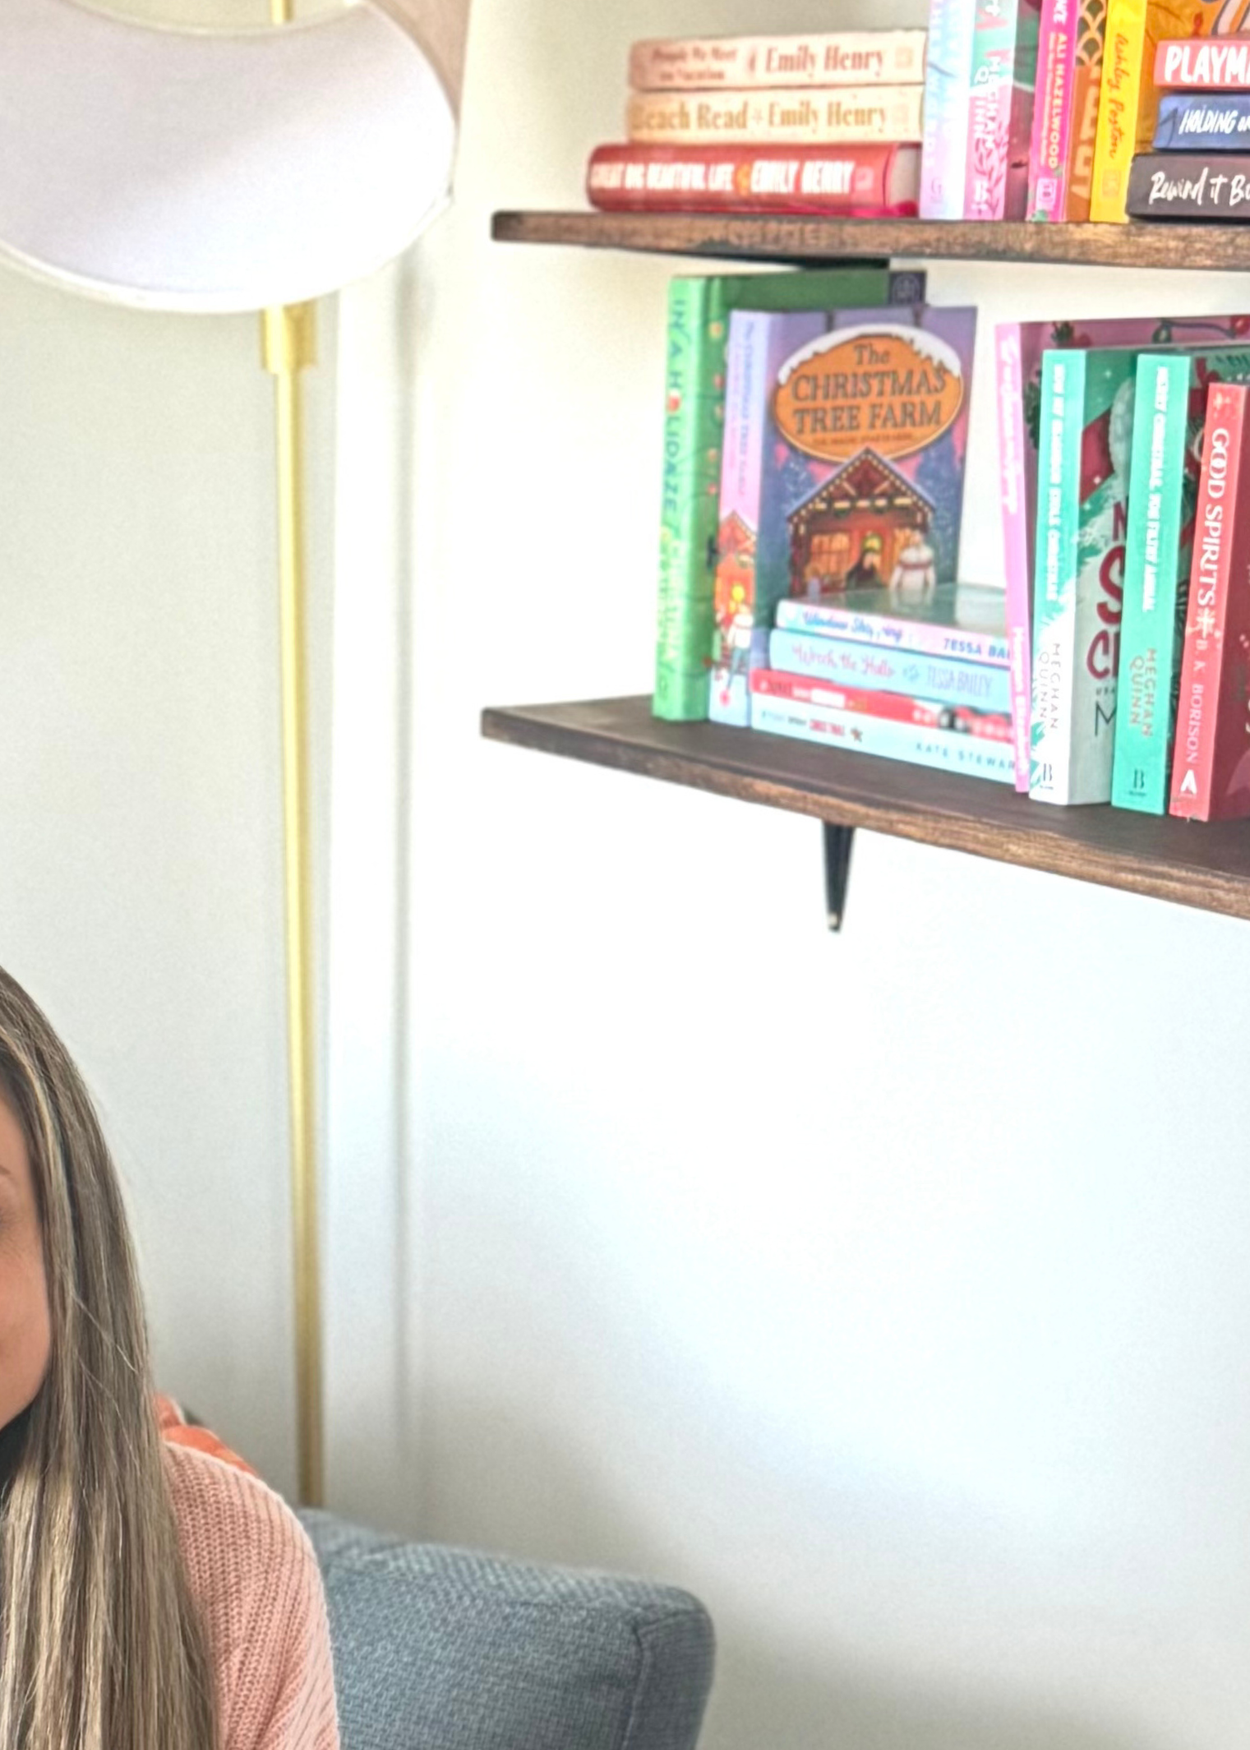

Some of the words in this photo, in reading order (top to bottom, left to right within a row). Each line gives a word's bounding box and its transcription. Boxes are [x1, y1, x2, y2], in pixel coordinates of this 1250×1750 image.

[765, 44, 816, 78] Emily
[823, 44, 884, 77] Henry
[1056, 32, 1068, 58] ALI
[1107, 32, 1130, 91] Ashley
[1164, 45, 1250, 85] PLAYM
[697, 100, 749, 130] Read
[768, 100, 819, 134] Emily
[826, 101, 886, 133] Henry
[986, 56, 1001, 149] MEGHAN
[1048, 64, 1065, 169] HAZELWOOD
[1108, 98, 1126, 160] Poston
[1178, 106, 1238, 135] HOLDING
[750, 159, 800, 194] EMILY
[800, 159, 856, 195] HENRY
[1148, 166, 1210, 206] Rewind
[1209, 173, 1229, 205] it
[669, 299, 685, 330] IN
[670, 339, 684, 359] A
[852, 341, 891, 366] The
[791, 367, 947, 402] CHRISTMAS
[793, 404, 861, 435] TREE
[867, 401, 942, 430] FARM
[1207, 427, 1230, 499] GOOD
[1197, 503, 1223, 607] SPIRITS
[839, 652, 857, 672] the
[944, 637, 982, 656] TESSA
[988, 645, 1010, 660] BAI
[926, 664, 956, 691] TESSA
[956, 670, 994, 699] BAILEY
[1038, 651, 1050, 720] QUINN
[1050, 642, 1062, 730] MEGHAN
[1129, 656, 1145, 727] QUINN
[1141, 647, 1158, 738] MEGHAN
[1186, 682, 1205, 764] BORISON
[916, 742, 949, 758] KATE
[958, 750, 1016, 770] STEWAR
